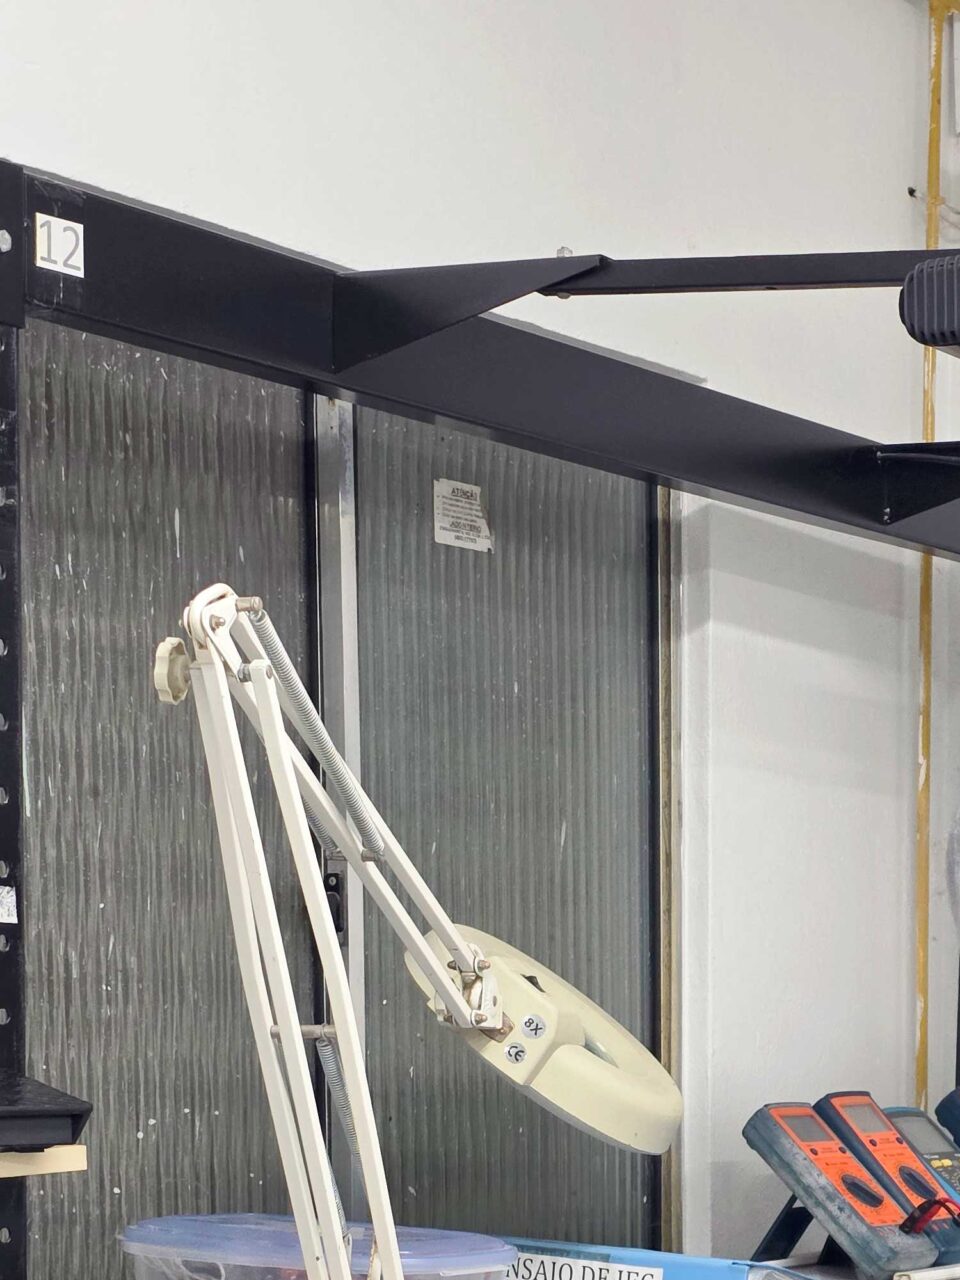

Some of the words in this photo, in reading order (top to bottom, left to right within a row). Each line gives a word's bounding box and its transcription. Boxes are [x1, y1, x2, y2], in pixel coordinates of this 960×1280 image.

[40, 220, 81, 271] 12
[525, 1018, 543, 1036] 8X
[508, 1045, 525, 1062] CE
